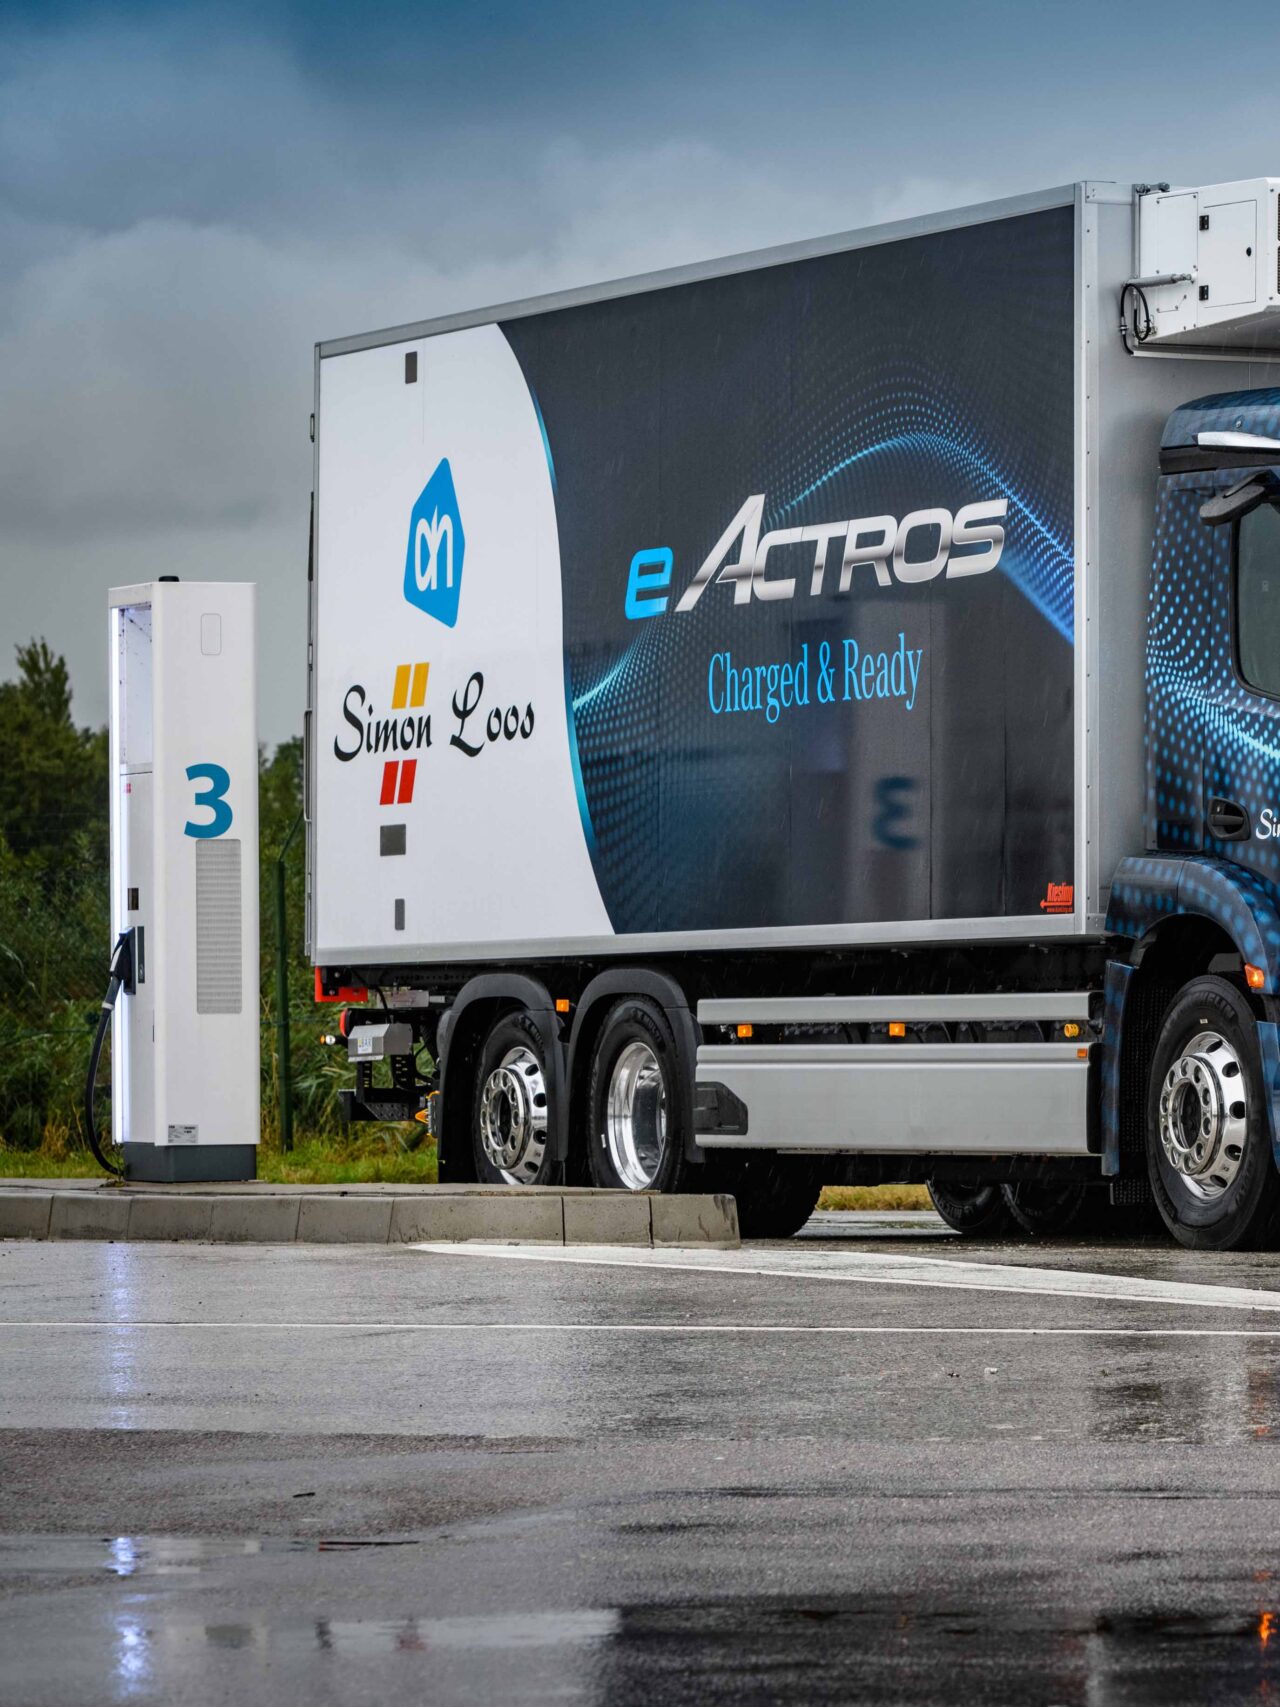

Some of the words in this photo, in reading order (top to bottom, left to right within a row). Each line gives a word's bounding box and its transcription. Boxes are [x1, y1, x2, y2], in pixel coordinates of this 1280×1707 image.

[334, 684, 432, 762] Simon
[449, 671, 535, 758] Loos
[708, 643, 809, 724] Charged
[816, 640, 836, 704] &
[842, 632, 923, 710] Ready
[183, 762, 234, 839] 3
